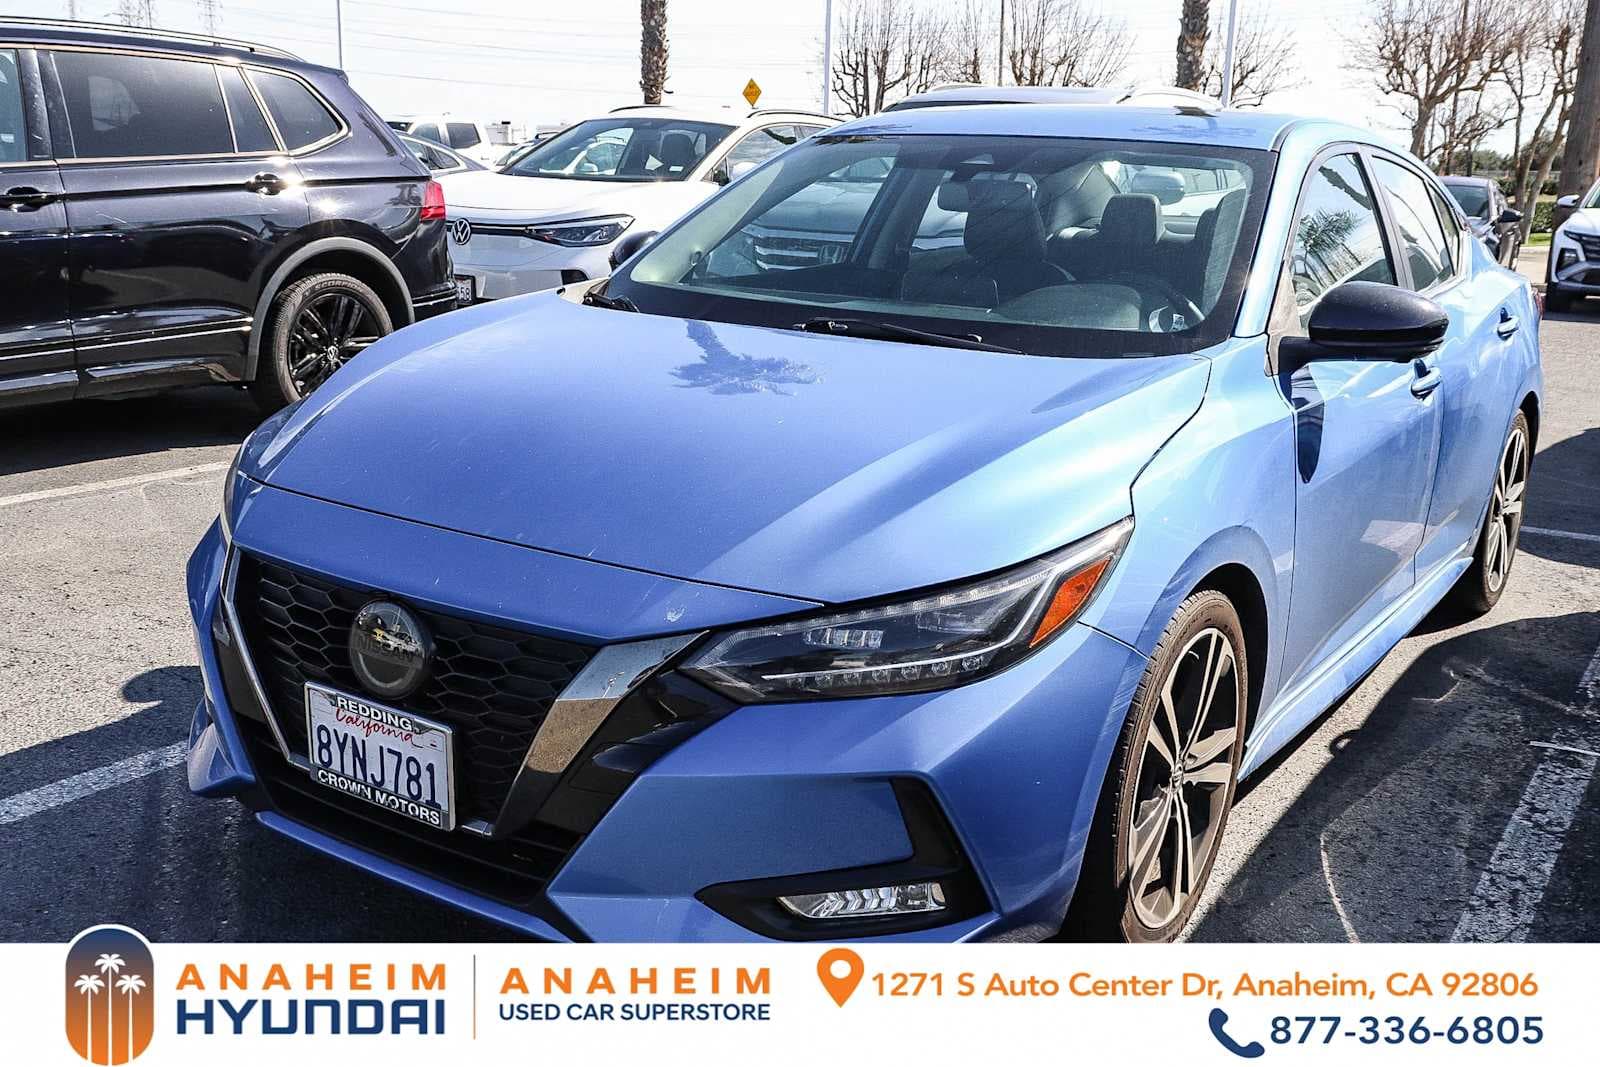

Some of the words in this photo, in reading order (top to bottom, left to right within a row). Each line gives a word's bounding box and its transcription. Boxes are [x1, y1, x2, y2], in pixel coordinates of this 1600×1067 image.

[335, 696, 413, 732] REDDING
[316, 724, 442, 811] 8YNJ781
[317, 769, 372, 800] CROWN
[375, 789, 440, 826] MOTORS
